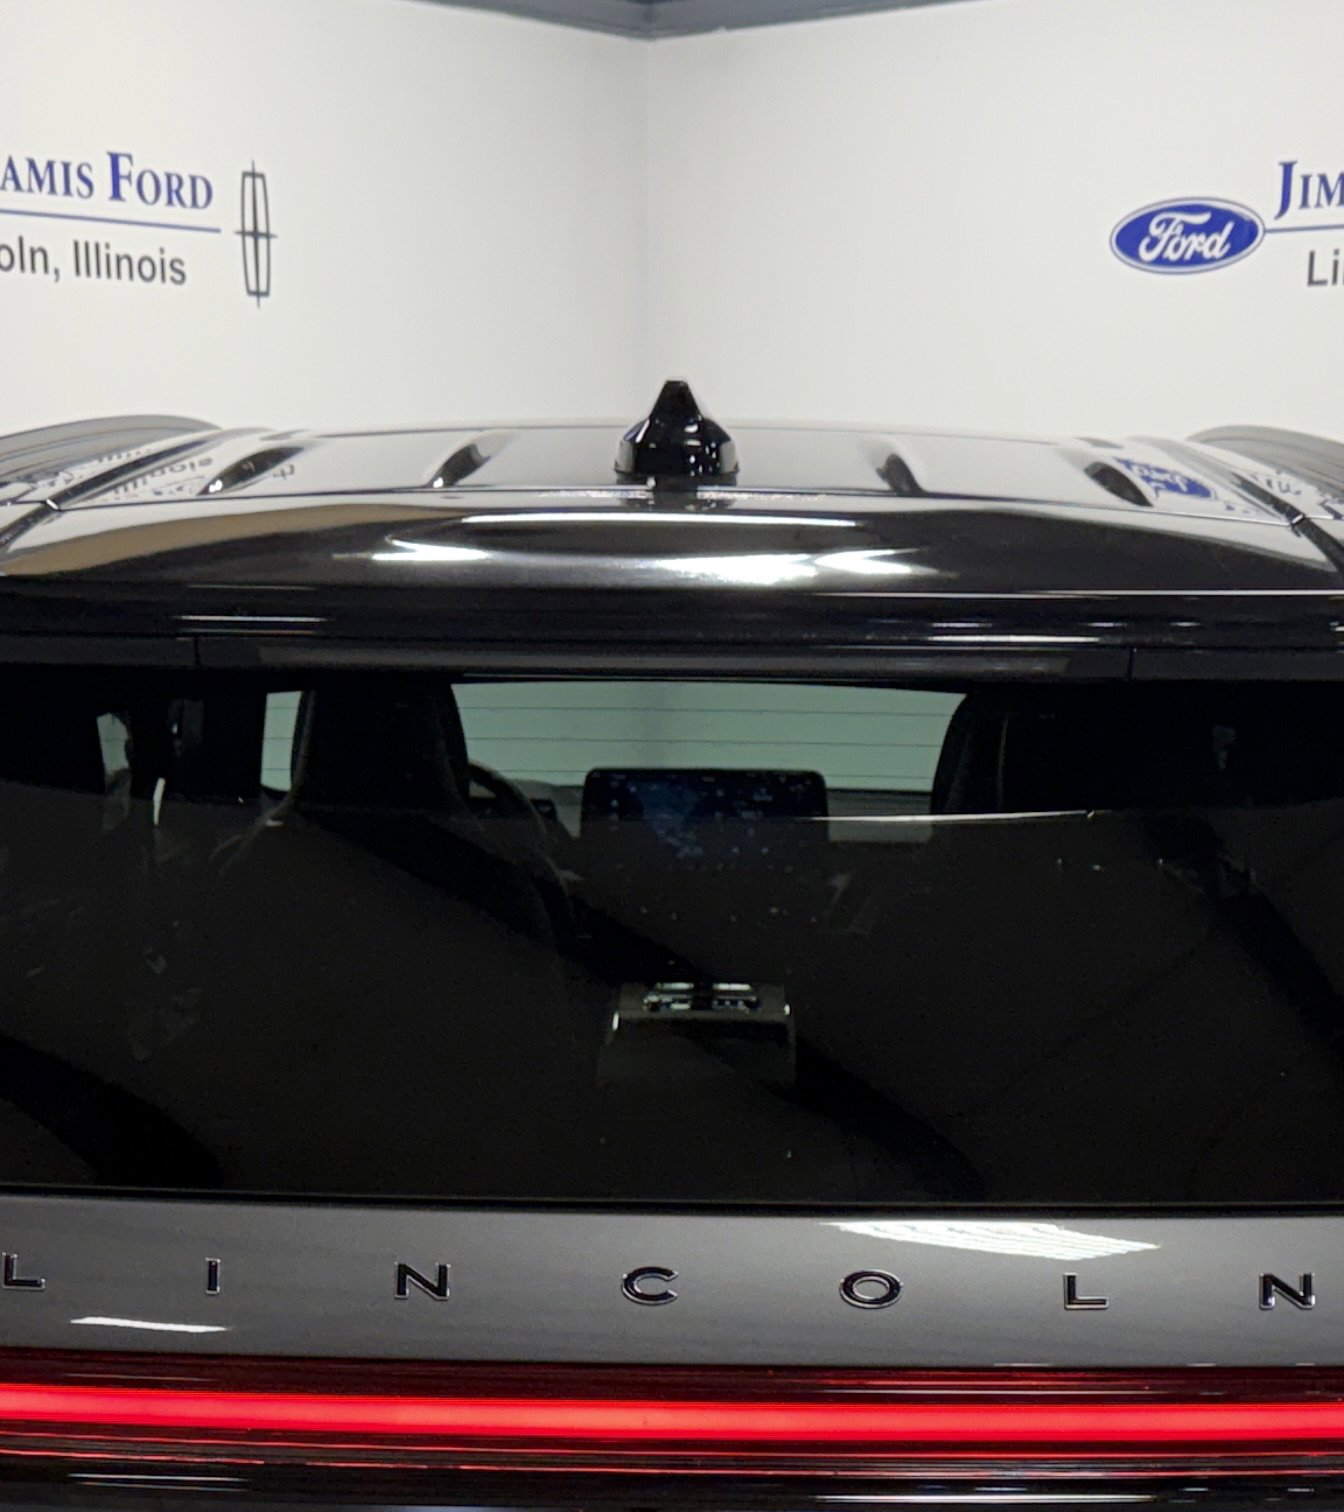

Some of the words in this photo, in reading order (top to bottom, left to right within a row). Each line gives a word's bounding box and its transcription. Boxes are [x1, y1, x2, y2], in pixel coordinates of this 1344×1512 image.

[106, 151, 213, 210] FORD
[72, 240, 187, 286] Illinois
[1138, 211, 1236, 262] Ford
[0, 1251, 1317, 1312] LINCOLN
